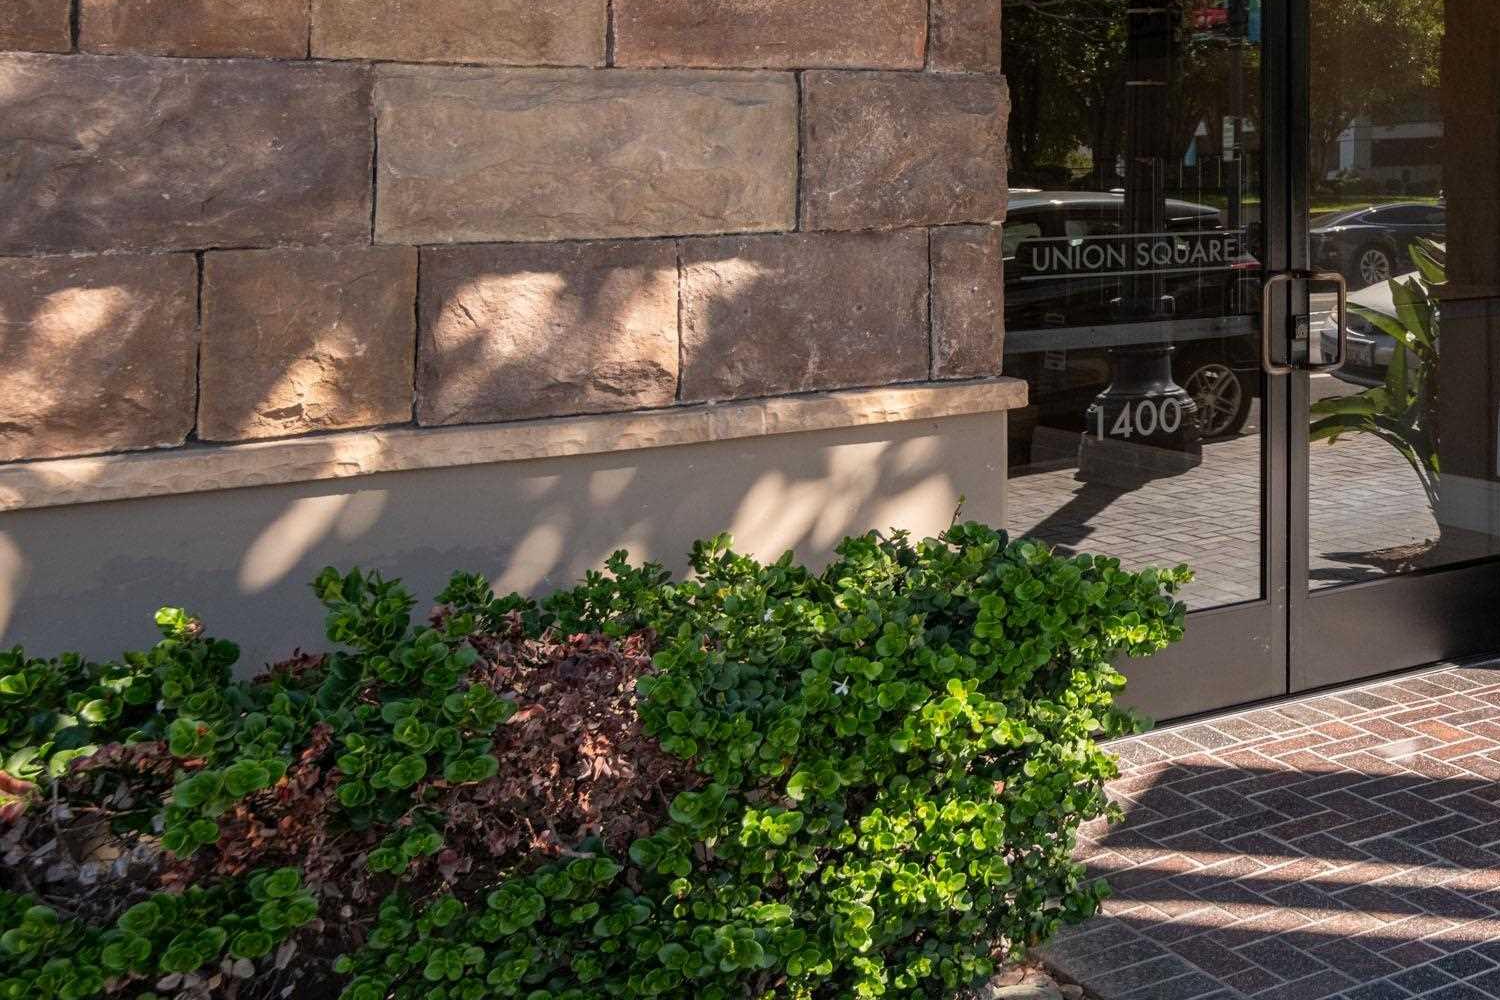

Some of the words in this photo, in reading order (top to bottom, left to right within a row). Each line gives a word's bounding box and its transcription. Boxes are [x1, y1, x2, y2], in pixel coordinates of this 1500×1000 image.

[1033, 245, 1125, 270] UNION
[1137, 239, 1236, 265] SQUARE
[1094, 398, 1182, 440] 1400
